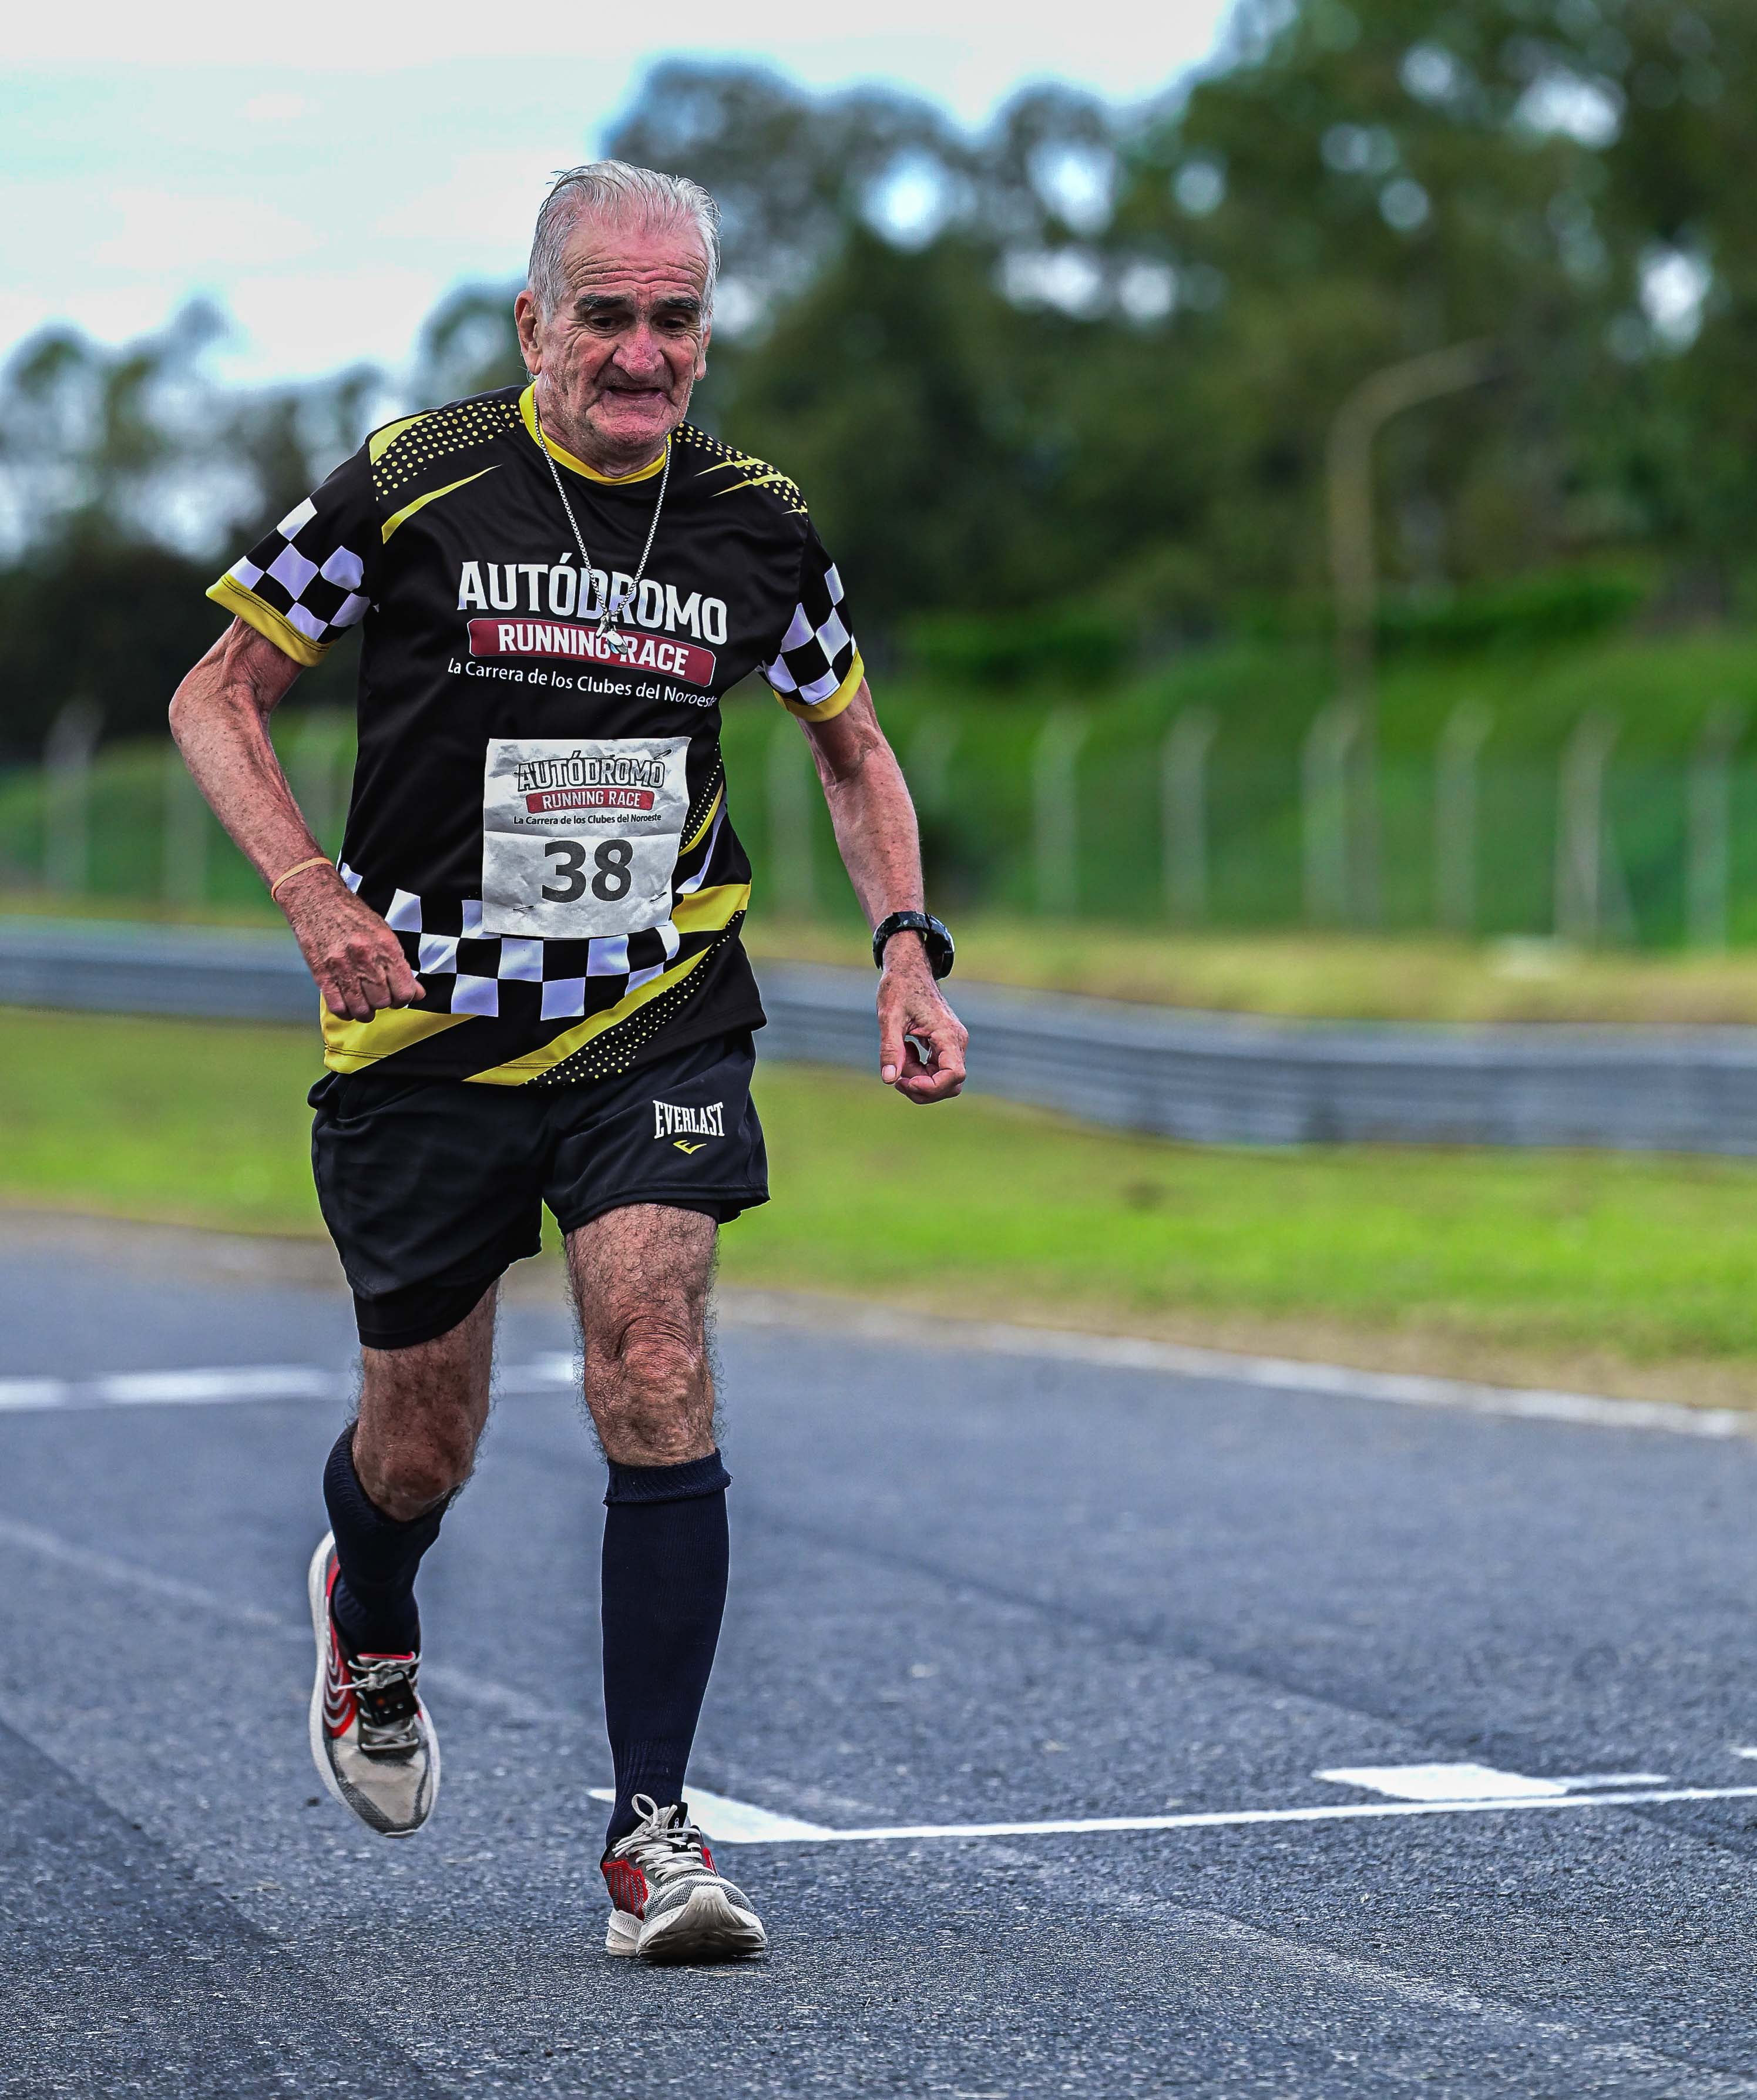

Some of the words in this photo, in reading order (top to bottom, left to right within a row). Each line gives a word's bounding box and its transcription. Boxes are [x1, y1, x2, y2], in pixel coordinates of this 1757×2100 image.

[456, 553, 728, 645] AUTÓDROMO
[498, 624, 611, 659] RUNNING
[620, 636, 690, 676] RACE
[448, 657, 461, 674] La
[465, 661, 523, 682] Carrera
[528, 668, 547, 685] de
[551, 671, 573, 689] los
[577, 676, 632, 695] Clubes
[636, 683, 660, 700] del
[517, 750, 666, 792] AUTÓDROMO
[513, 815, 524, 825] La
[525, 816, 558, 825] Carrera
[560, 815, 571, 824] de
[573, 815, 586, 824] los
[587, 815, 615, 824] Clubes
[617, 814, 629, 823] del
[630, 814, 662, 823] Noroeste
[542, 791, 604, 809] RUNNING
[609, 791, 641, 808] RACE
[541, 839, 633, 903] 38
[653, 1100, 725, 1139] EVERLAST
